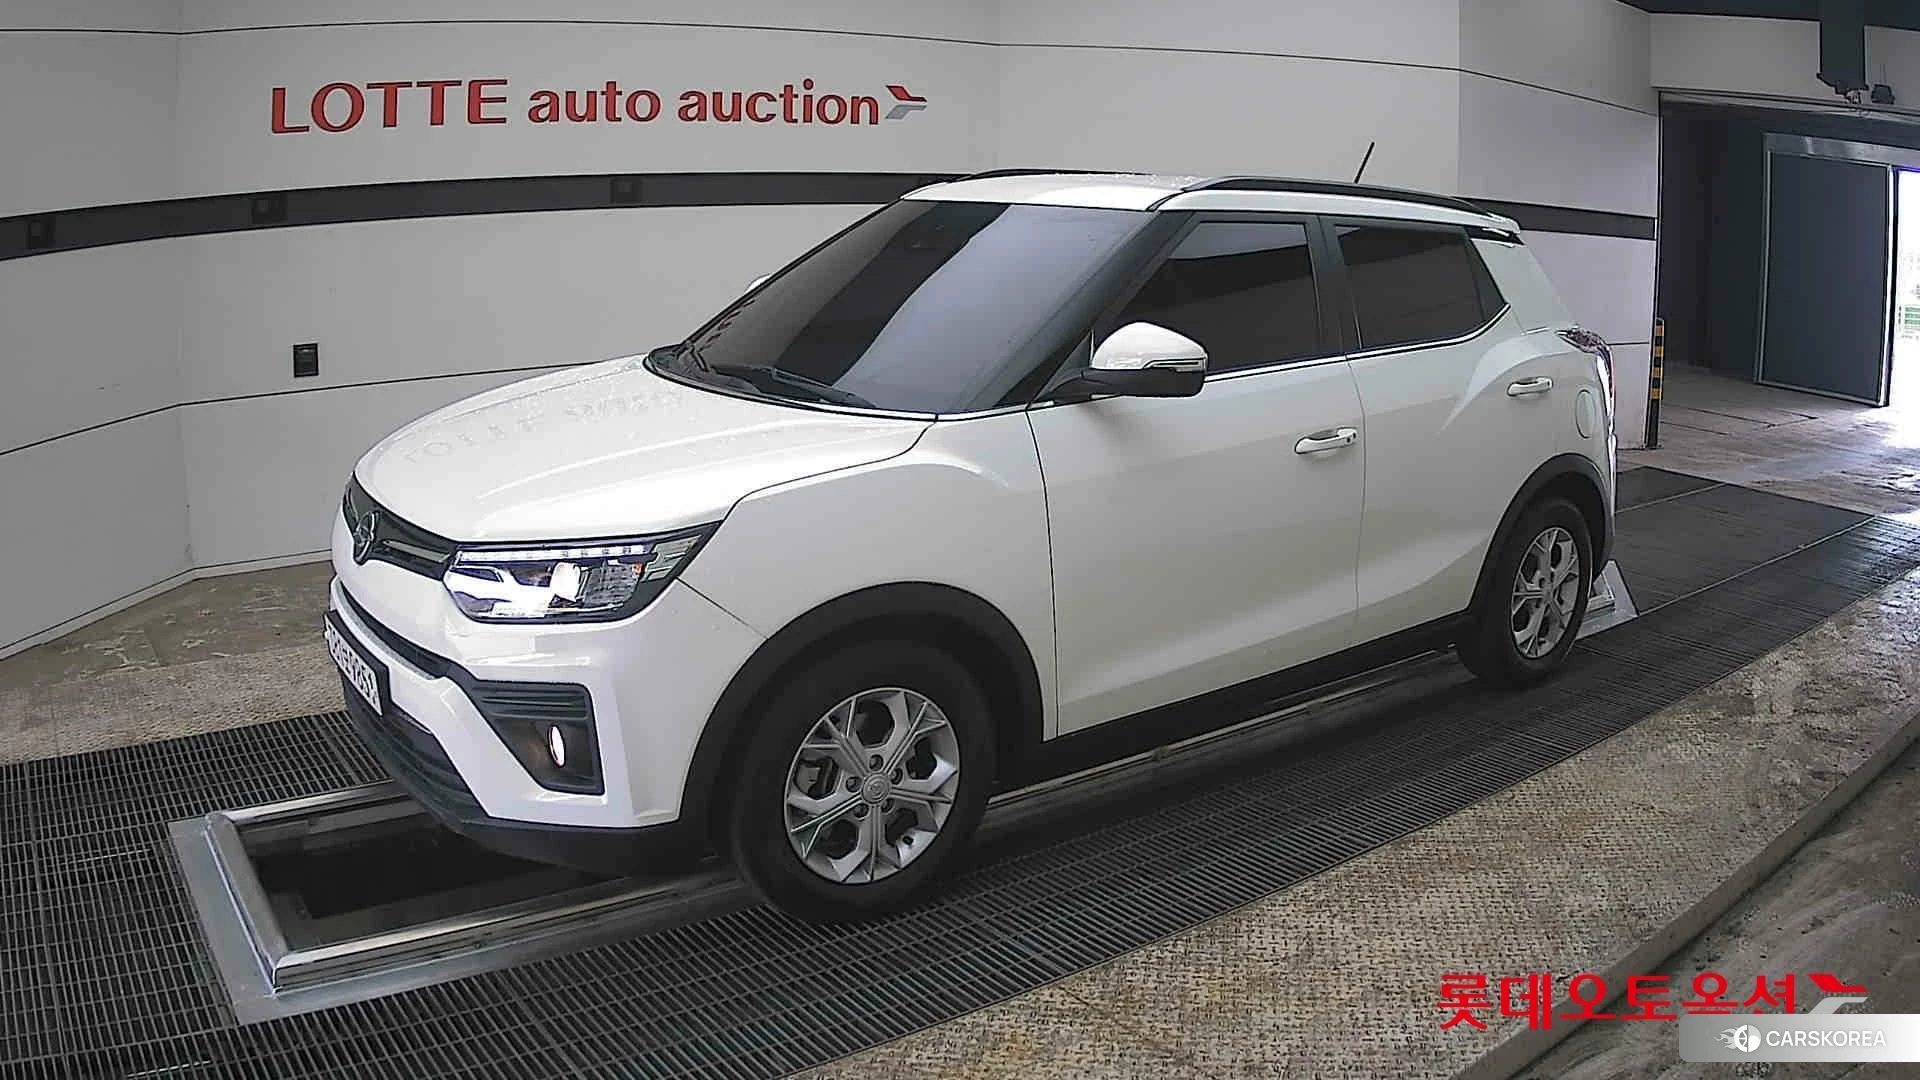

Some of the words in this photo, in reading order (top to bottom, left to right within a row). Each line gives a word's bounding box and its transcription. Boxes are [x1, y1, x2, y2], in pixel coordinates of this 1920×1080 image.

[271, 79, 508, 134] LOTTE
[527, 81, 662, 125] auto
[677, 79, 881, 126] auction
